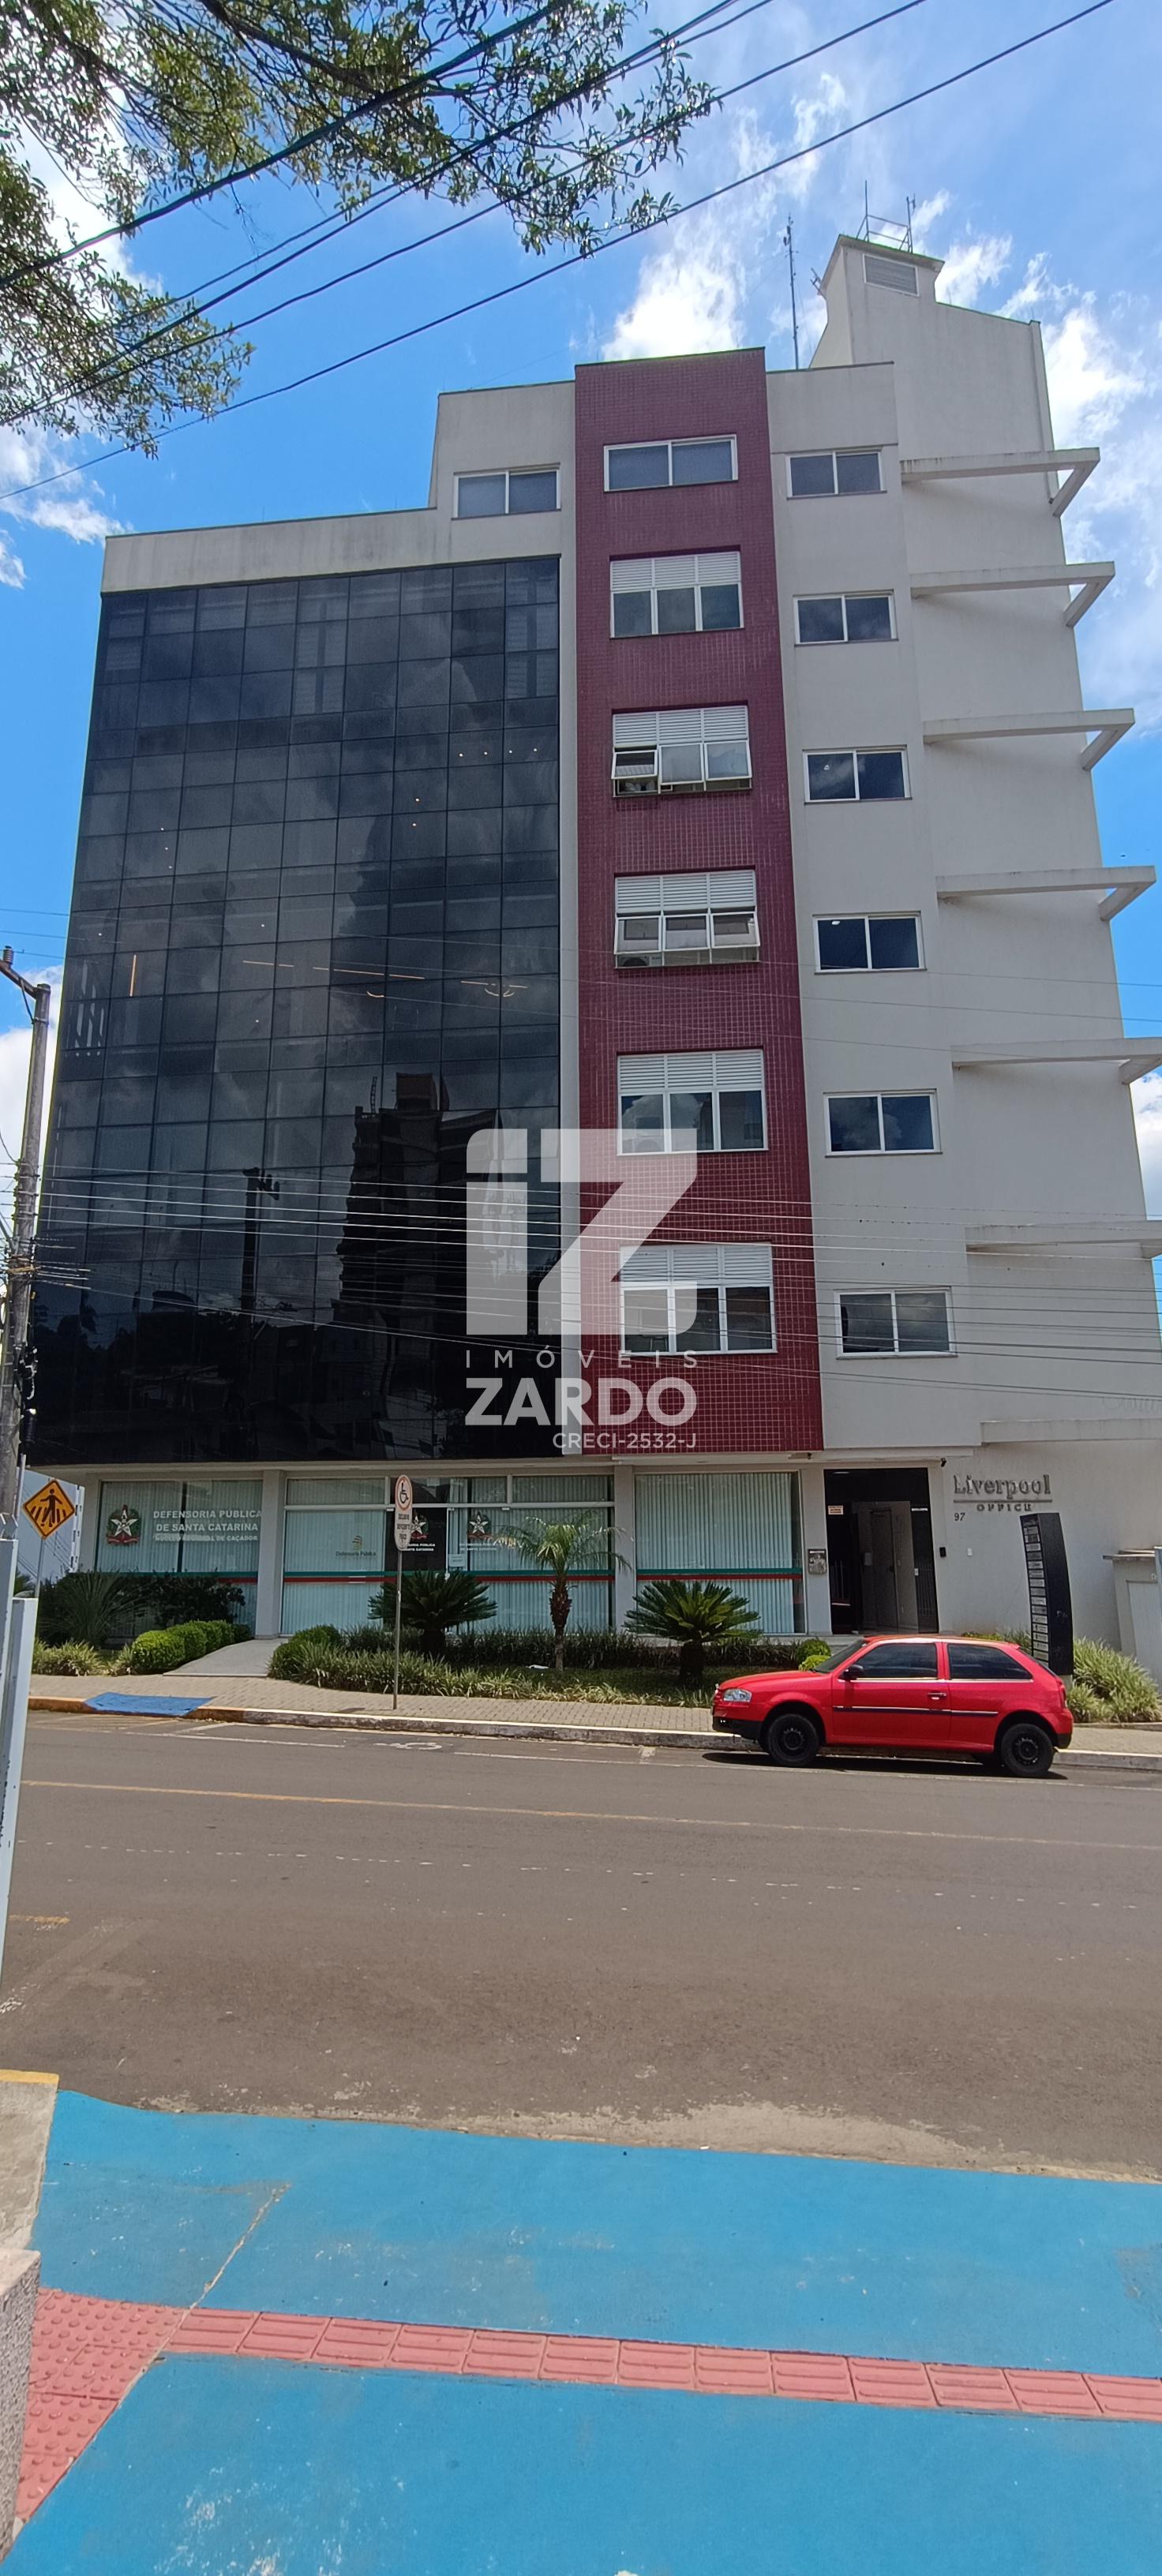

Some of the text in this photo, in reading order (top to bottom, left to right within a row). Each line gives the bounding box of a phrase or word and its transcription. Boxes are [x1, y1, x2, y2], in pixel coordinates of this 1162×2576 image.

[953, 1474, 1051, 1500] Liverpool
[153, 1509, 261, 1518] DEFENSORIA PÚBLICA
[954, 1512, 965, 1522] 97
[156, 1523, 258, 1532] DE SANTA CATARINA
